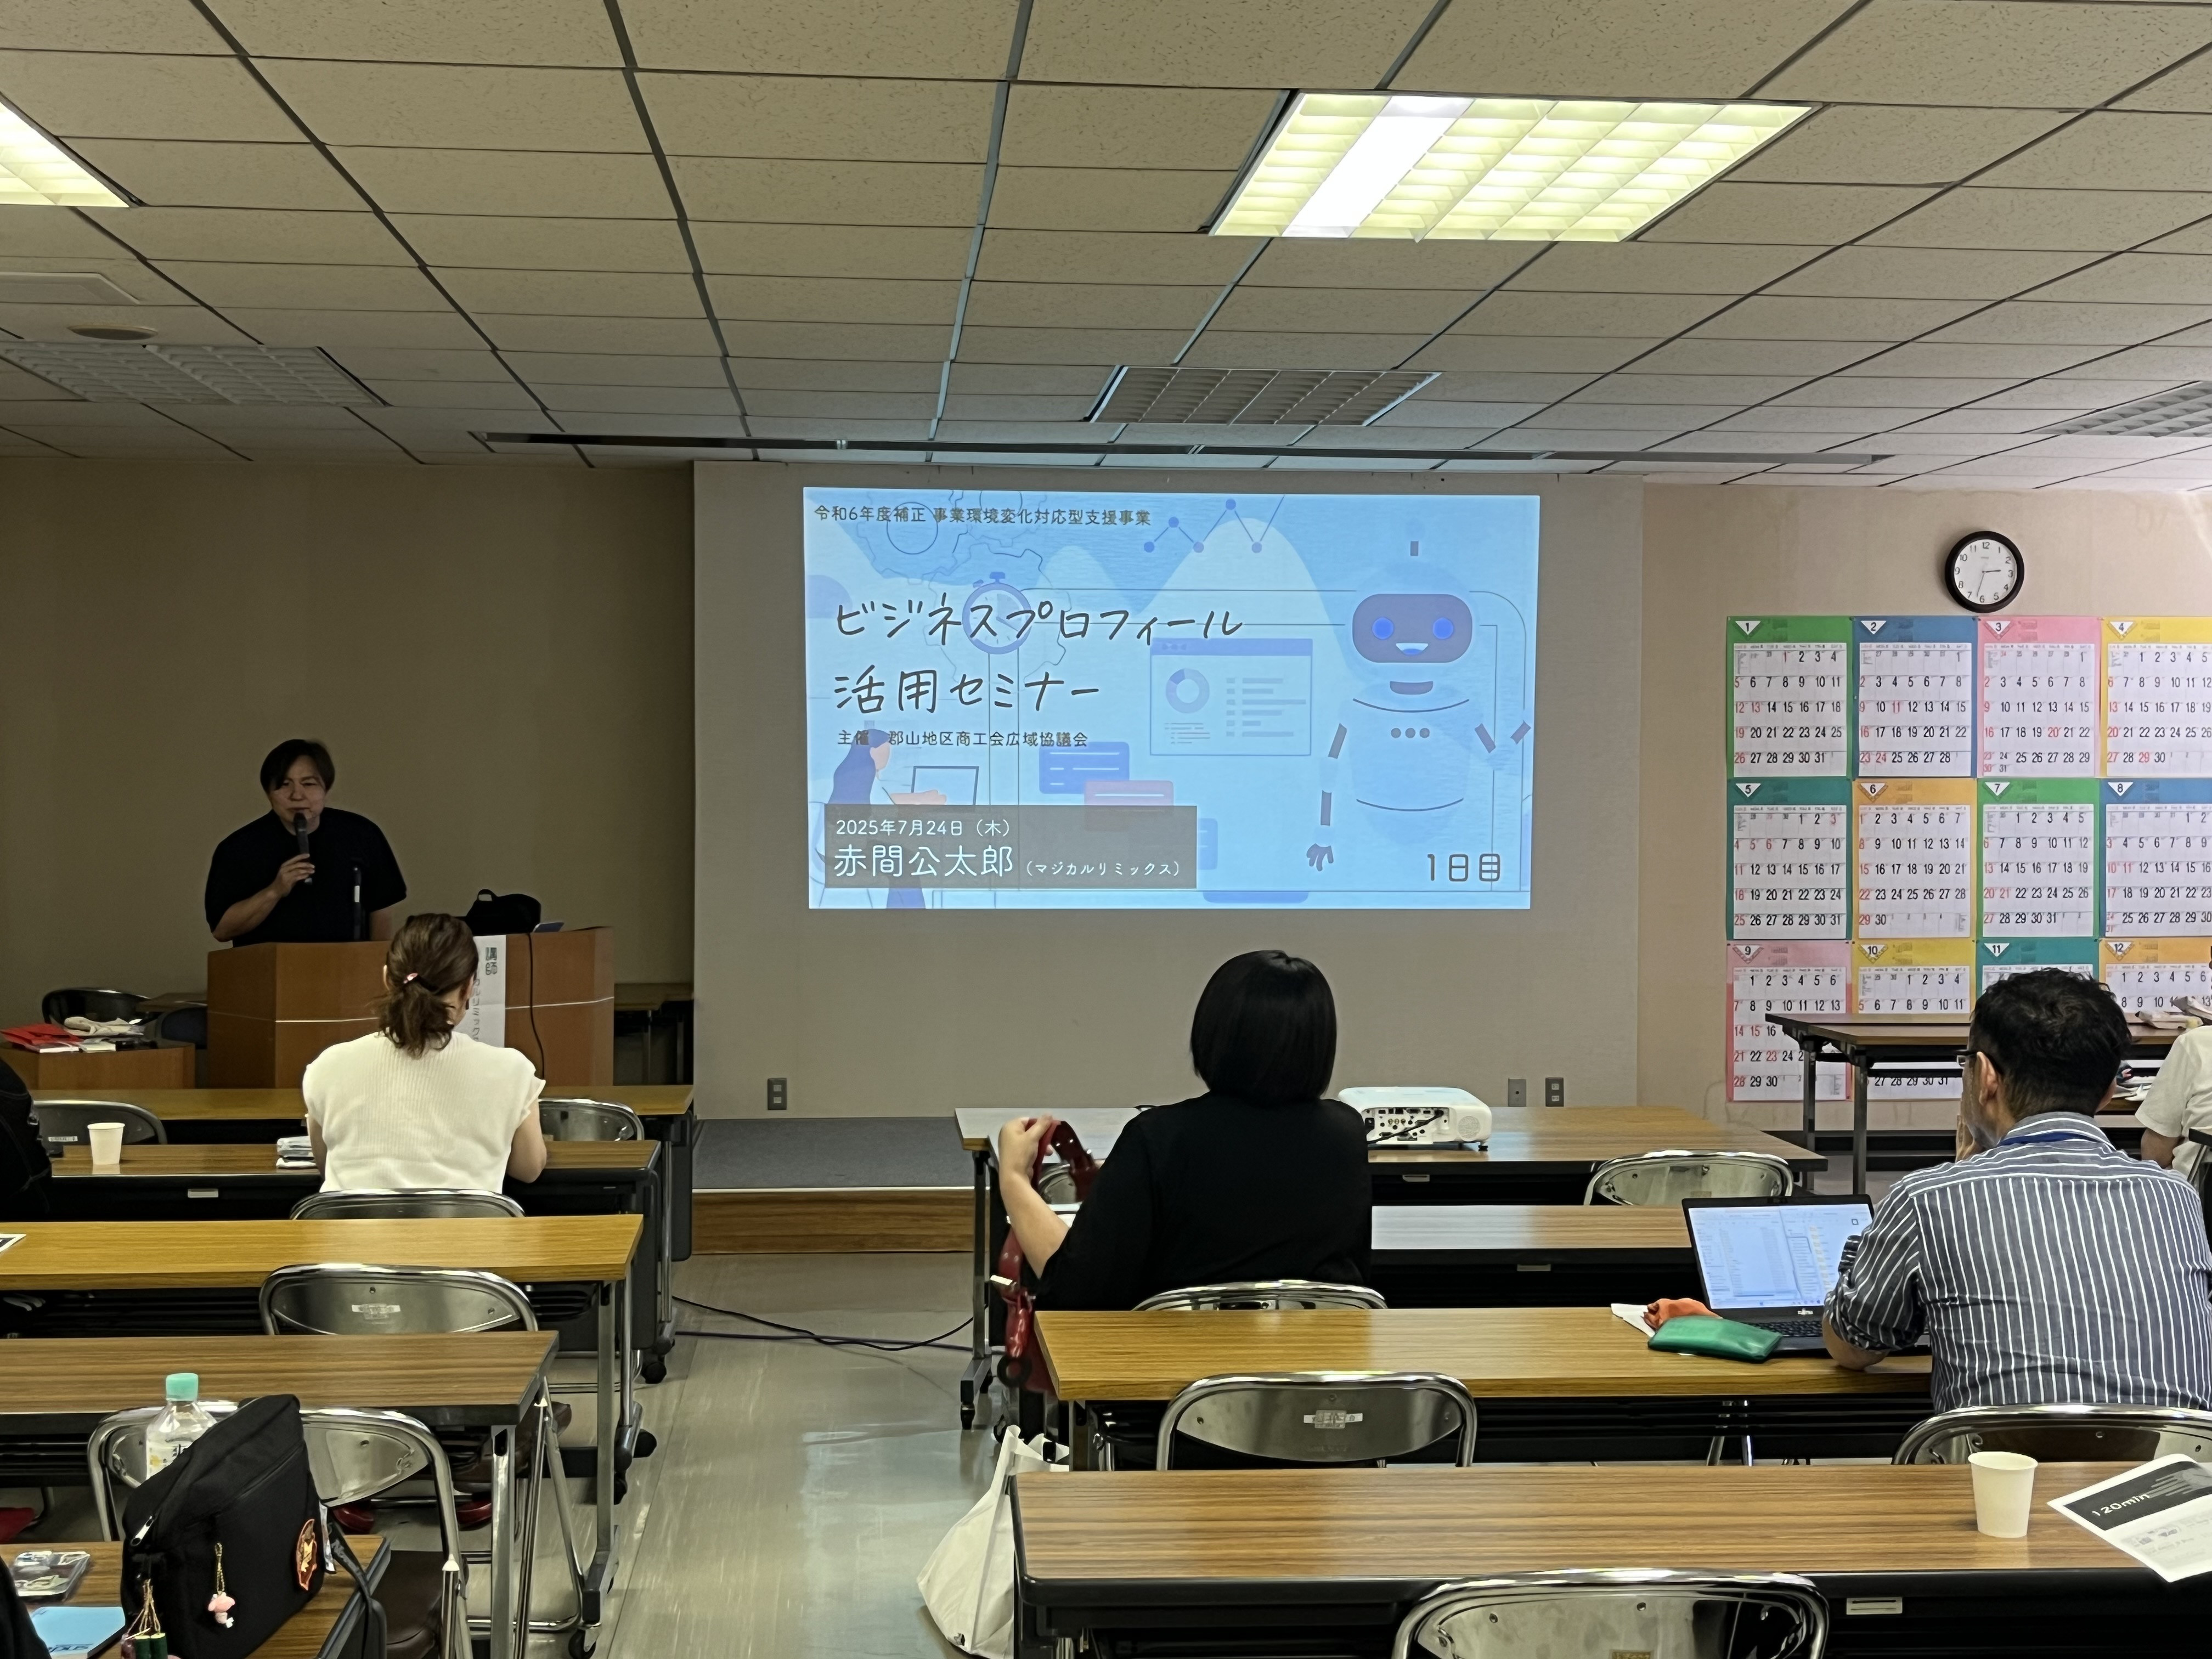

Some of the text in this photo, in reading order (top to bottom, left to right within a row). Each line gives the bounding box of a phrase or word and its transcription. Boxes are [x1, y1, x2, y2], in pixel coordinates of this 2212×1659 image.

[814, 505, 1151, 526] 令和6年度補正 事業環境変化対応型支援事業
[2008, 569, 2013, 578] 3
[837, 592, 1243, 646] ビジネスプロフィール
[1746, 623, 1750, 631] 1
[1871, 622, 1876, 631] 2
[1996, 623, 2001, 631] 3
[2119, 623, 2124, 631] 4
[1860, 676, 1961, 687] 2 3 4 5 6 7 8
[1984, 676, 2085, 687] 2 3 4 5 6 7 8
[834, 664, 1099, 714] 活用セミナー
[2109, 702, 2211, 713] 13 14 15 16 17 18 19
[1735, 726, 1842, 738] 19 20 21 22 23 24 25
[1860, 726, 1966, 737] 16 17 18 19 20 21 22
[2108, 727, 2211, 737] 20 21 22 23 24 25 26
[838, 730, 1088, 748] 主催 郡山地区商工会広域協議会
[1735, 752, 1824, 763] 26 27 28 29 30 31
[1745, 785, 1751, 794] 5
[1870, 785, 1876, 794] 6
[1995, 784, 2000, 793] 7
[2118, 783, 2123, 793] 8
[2000, 837, 2088, 848] 7 8 9 10 11 12
[1427, 853, 1501, 882] 1日目
[1735, 864, 1841, 874] 11 12 13 14 15 16 17
[1860, 864, 1964, 874] 15 16 17 18 19 20 21
[2108, 861, 2211, 873] 10 11 12 13 14 15 16
[1859, 888, 1966, 900] 22 23 24 25 26 27 28
[2123, 887, 2211, 898] 18 19 20 21 22 23
[1745, 946, 1751, 956] 9
[1867, 946, 1878, 955] 10
[1993, 945, 2000, 953] 11
[2114, 943, 2124, 952] 12
[1750, 975, 1836, 986] 1 2 3 4 5 6
[2122, 971, 2206, 982] 1 2 3 4 5 6
[1735, 1000, 1840, 1011] 7 8 9 10 11 12 13
[1859, 999, 1962, 1010] 5 6 7 8 9 10 11
